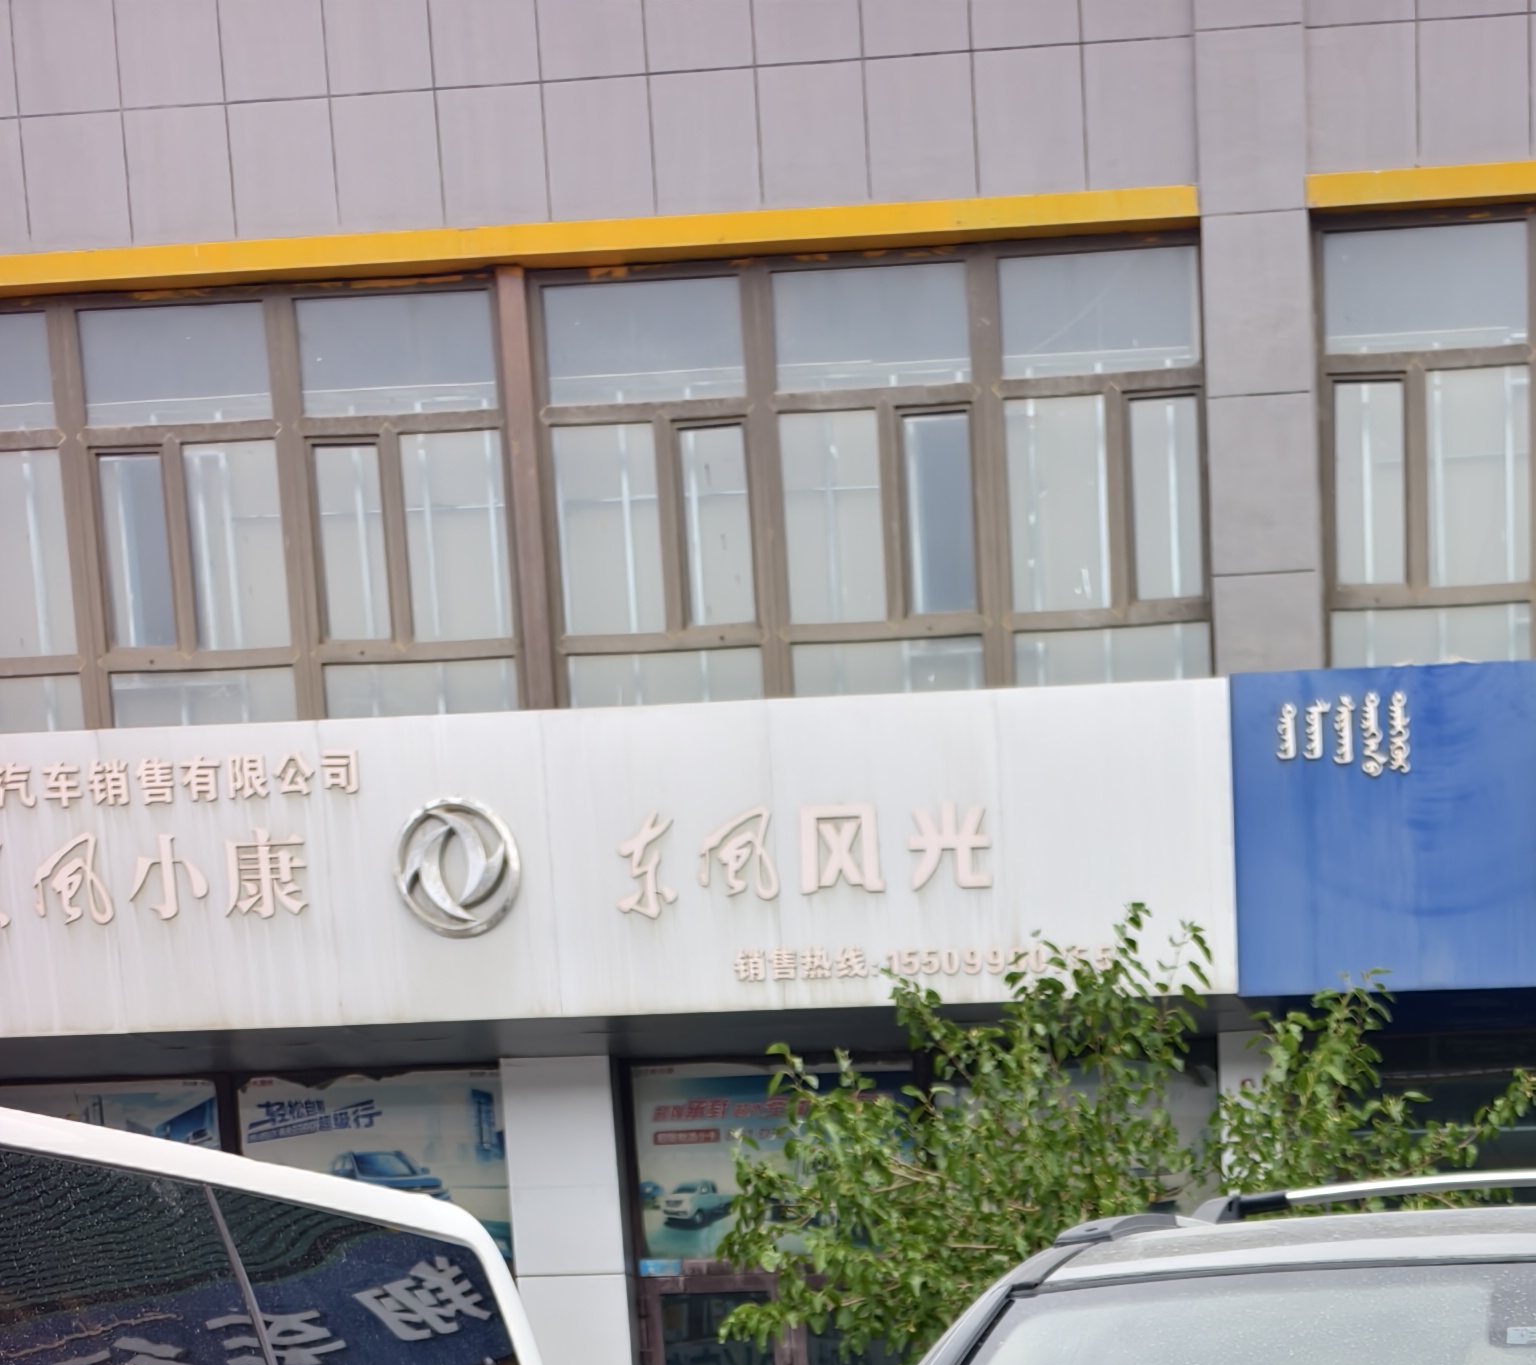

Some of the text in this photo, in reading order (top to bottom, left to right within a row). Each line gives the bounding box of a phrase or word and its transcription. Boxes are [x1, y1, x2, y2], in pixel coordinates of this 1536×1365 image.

[0, 748, 359, 809] 汽车销售有限公司
[0, 826, 310, 926] 风小康
[617, 802, 994, 921] 东风风光
